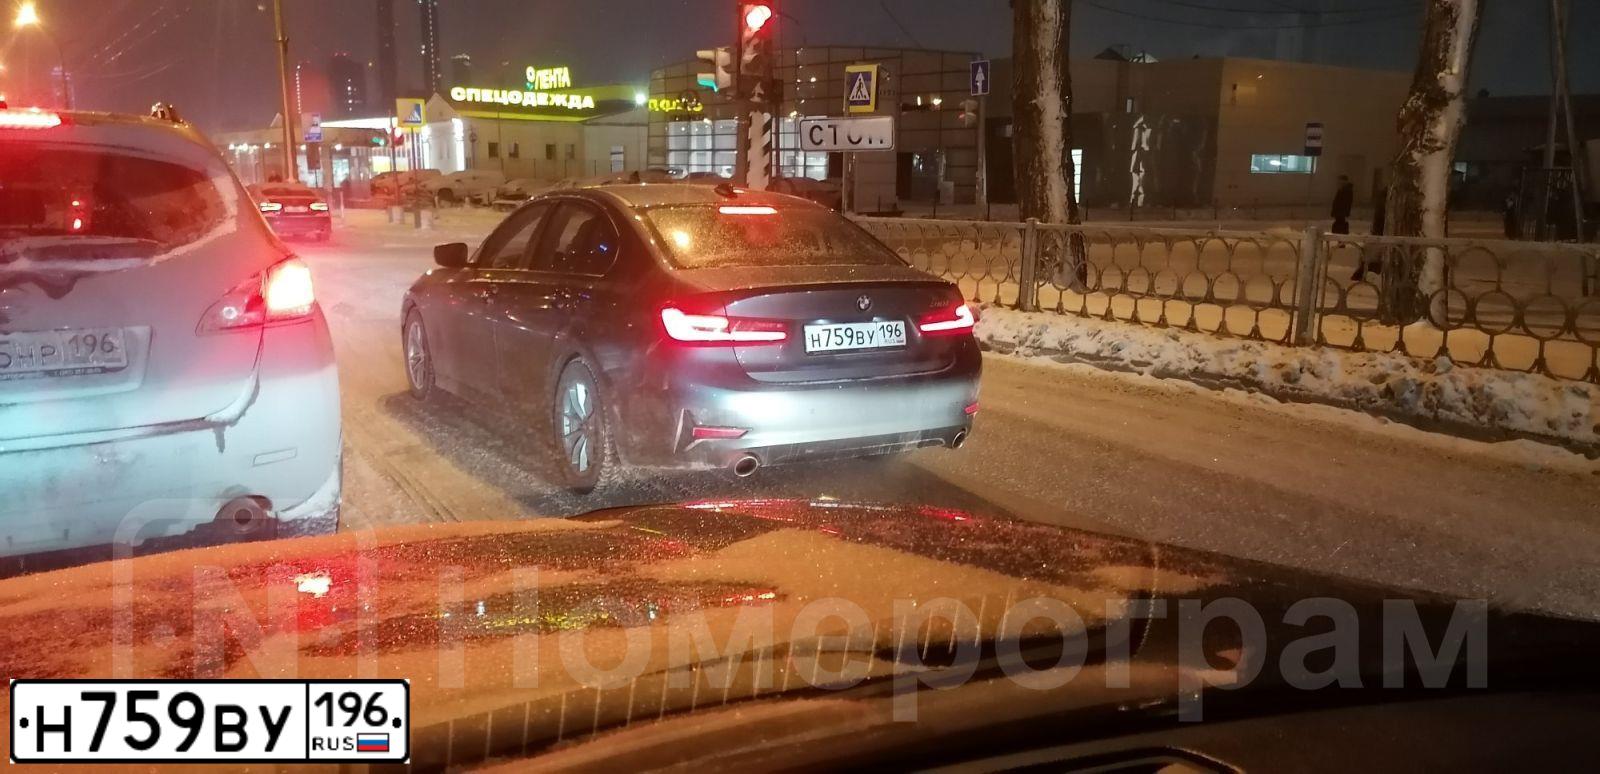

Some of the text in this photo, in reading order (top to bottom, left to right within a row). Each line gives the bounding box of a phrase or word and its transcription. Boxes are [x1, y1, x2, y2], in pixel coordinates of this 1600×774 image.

[534, 66, 571, 90] ЛЕНТА
[450, 86, 595, 110] СПЕЦОДЕЖДА
[809, 124, 884, 145] СТО
[68, 332, 115, 358] 196
[811, 323, 902, 348] Н759ВУ 196
